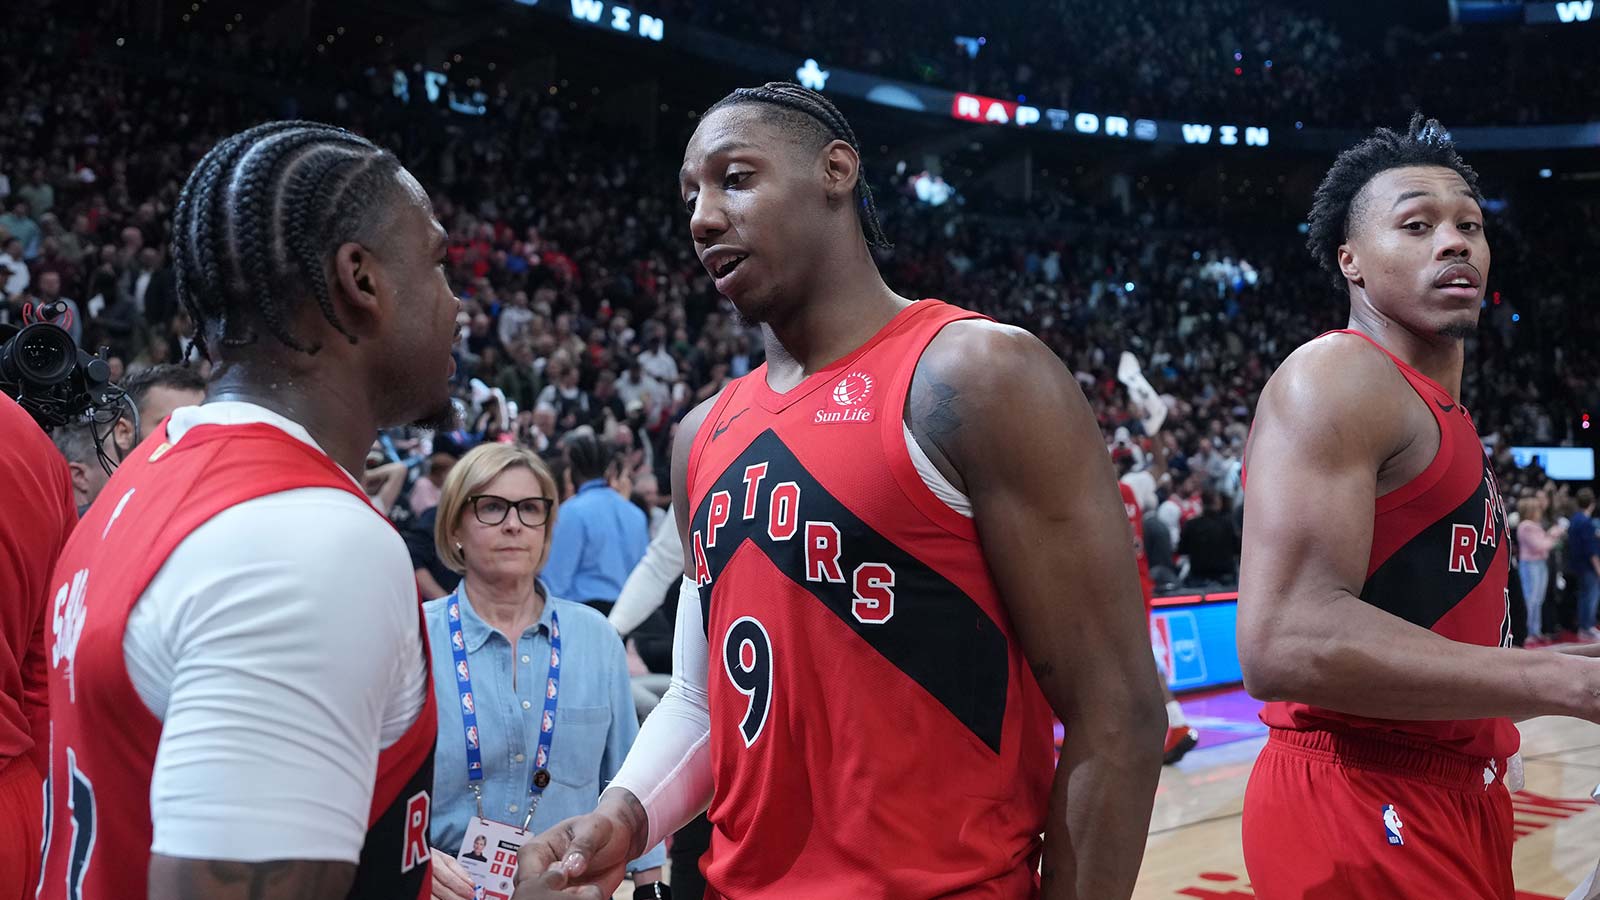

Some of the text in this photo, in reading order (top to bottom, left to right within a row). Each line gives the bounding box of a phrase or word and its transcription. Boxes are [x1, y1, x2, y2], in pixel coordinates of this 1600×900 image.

[570, 0, 664, 41] WIN
[957, 95, 1270, 147] RAPTORS WIN
[814, 407, 871, 423] Sun Life
[722, 615, 774, 750] 9
